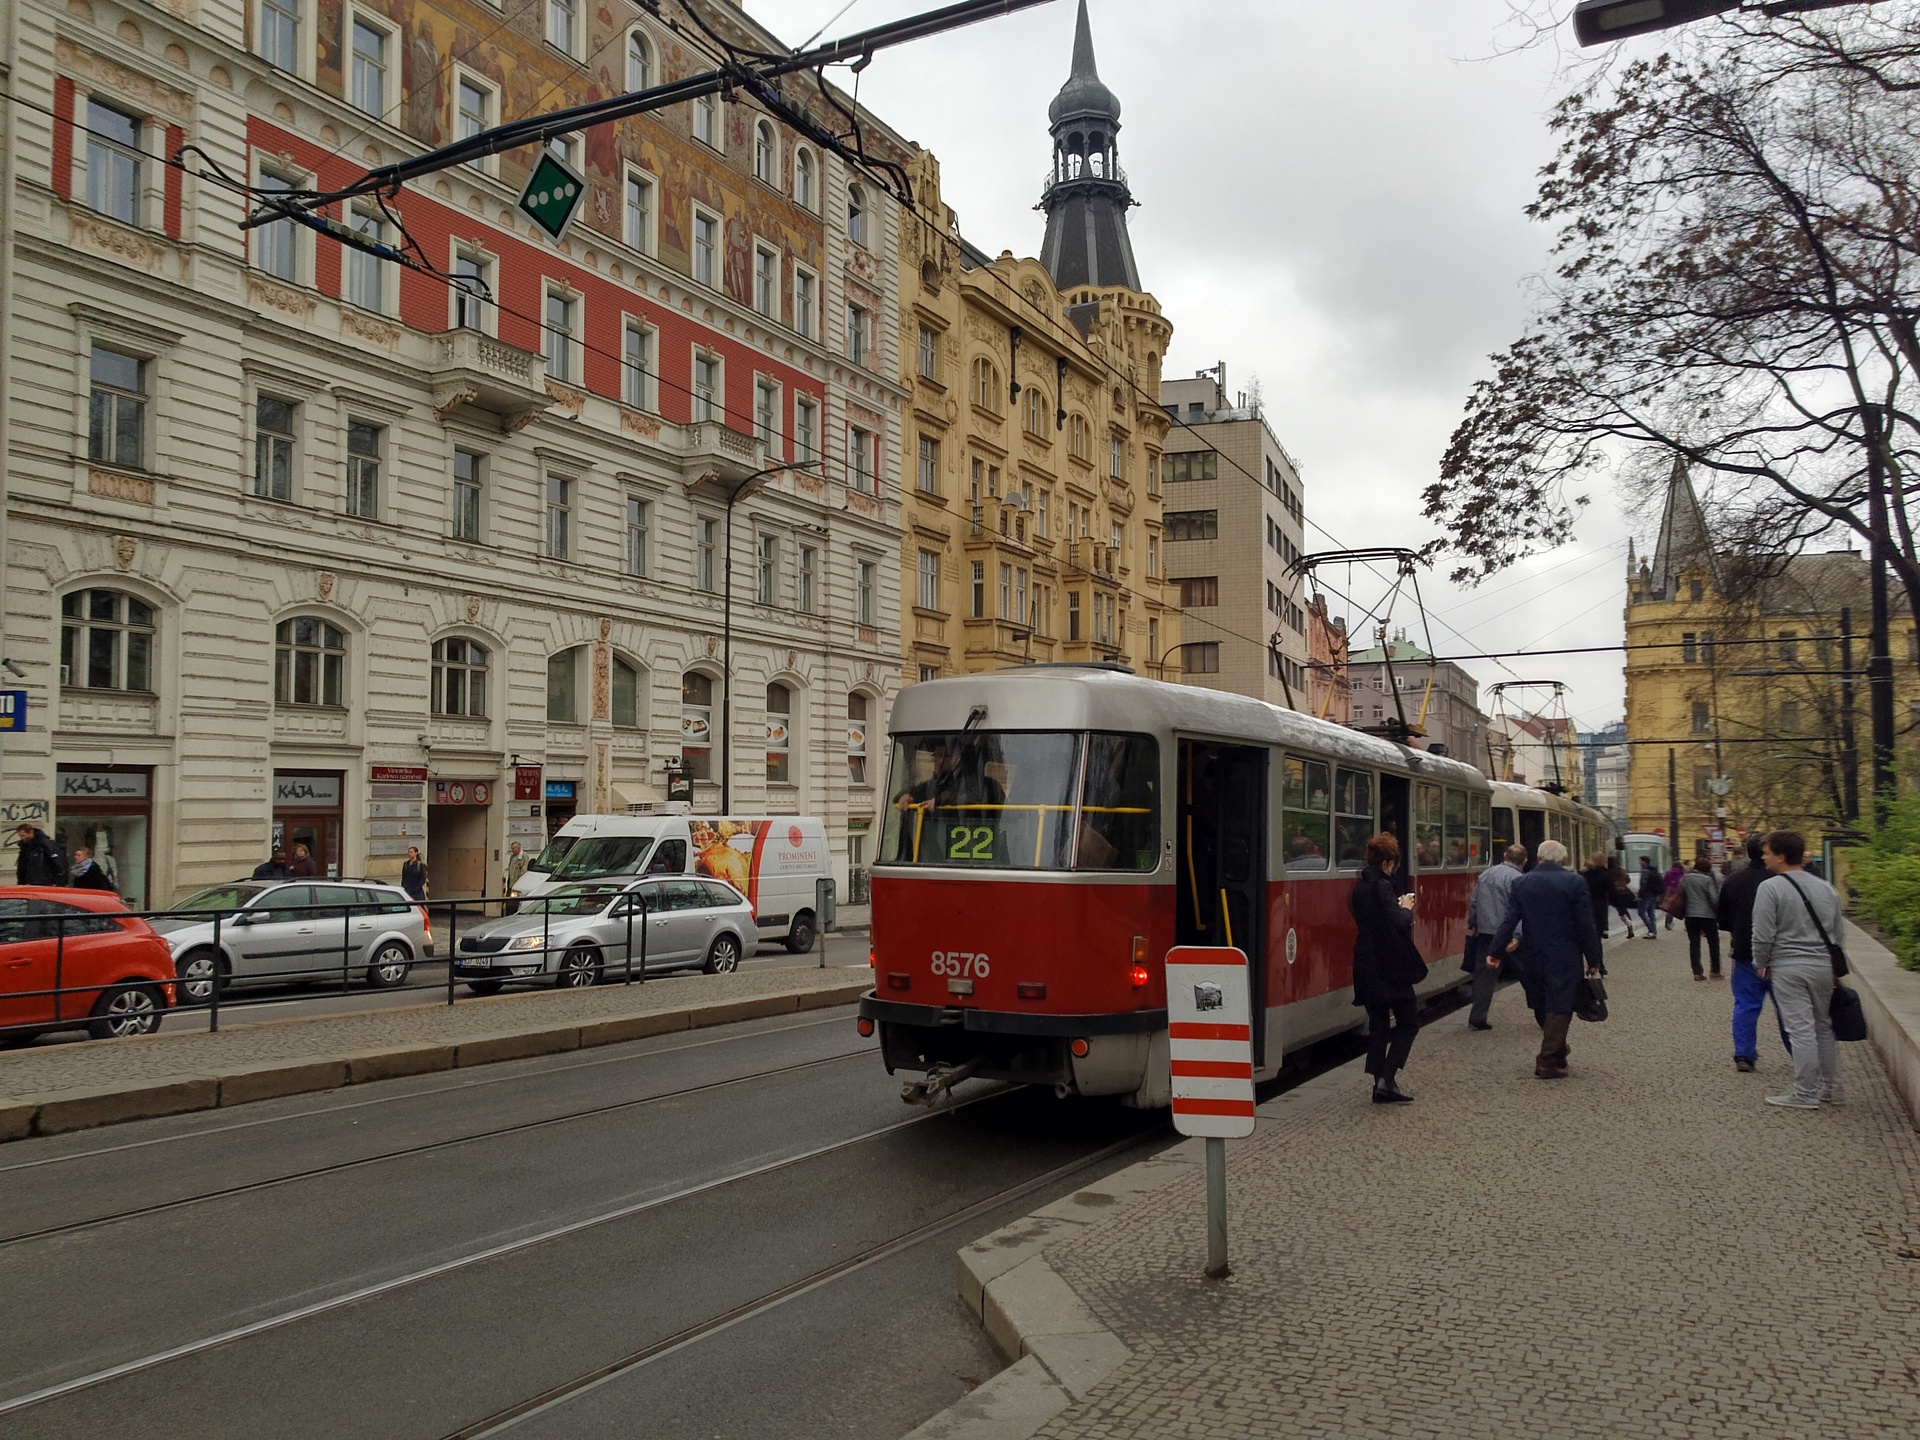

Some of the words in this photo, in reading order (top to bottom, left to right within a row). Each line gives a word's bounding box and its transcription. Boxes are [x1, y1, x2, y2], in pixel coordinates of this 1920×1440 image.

[64, 775, 113, 794] KÁJA
[277, 781, 315, 799] KÁJA
[519, 777, 537, 786] klub
[950, 826, 994, 859] 22
[778, 851, 817, 862] PROMINENT
[931, 951, 990, 979] 8576
